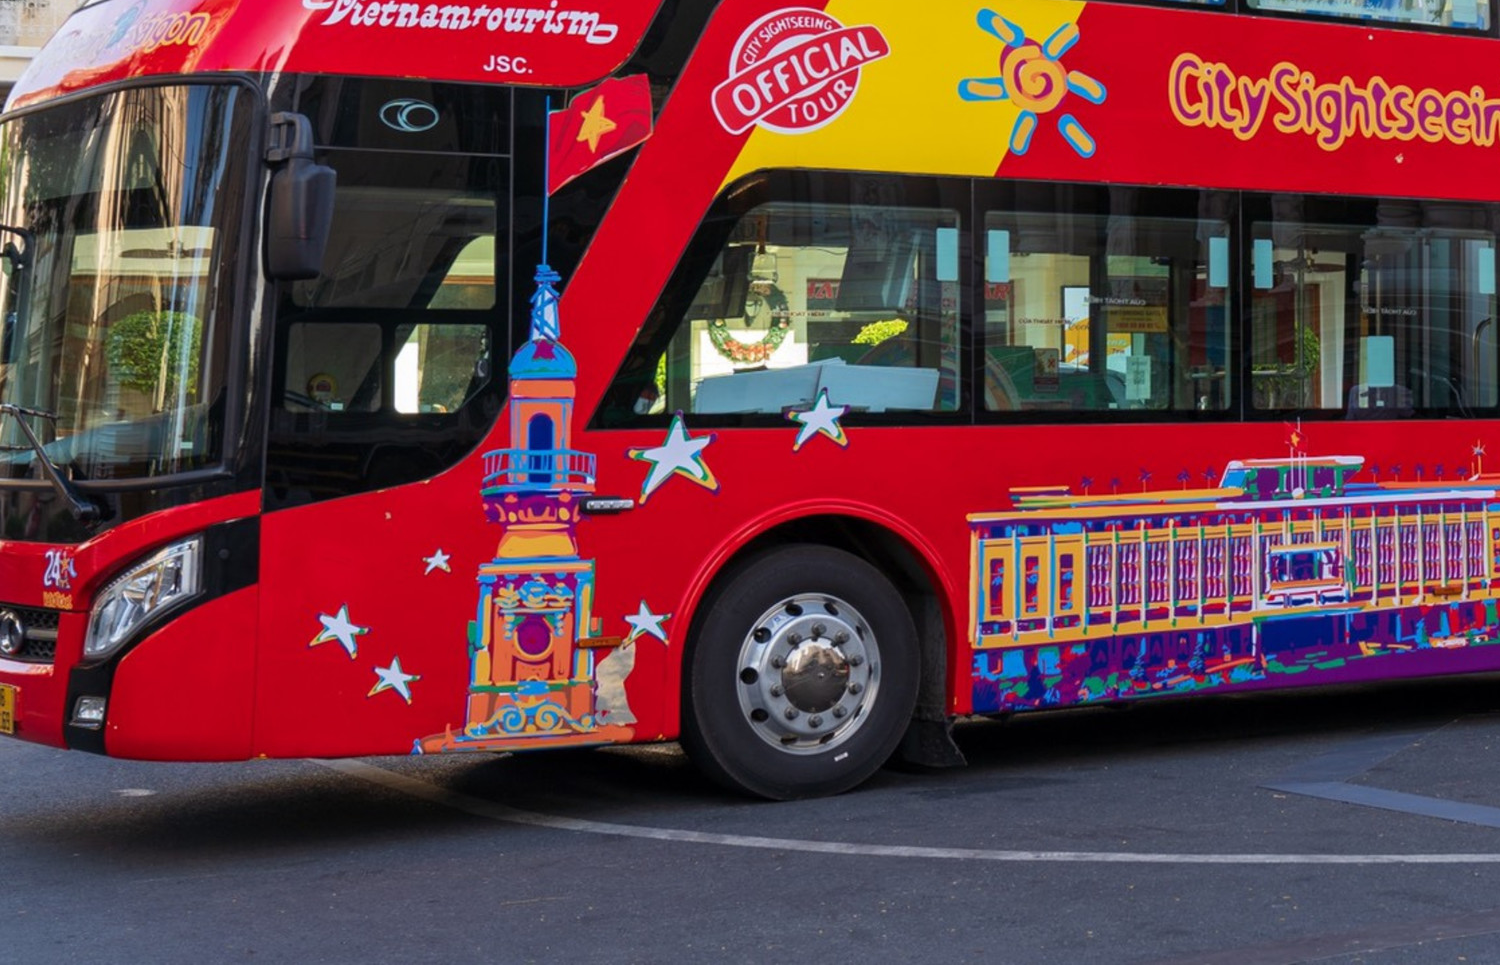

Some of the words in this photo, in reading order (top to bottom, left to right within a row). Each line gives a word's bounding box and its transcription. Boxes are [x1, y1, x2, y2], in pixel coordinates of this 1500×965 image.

[742, 36, 763, 65] CITY
[759, 16, 833, 42] SIGHTSEEING
[483, 55, 534, 74] JSC.
[732, 31, 880, 117] OFFICIAL
[788, 79, 853, 124] TOUR
